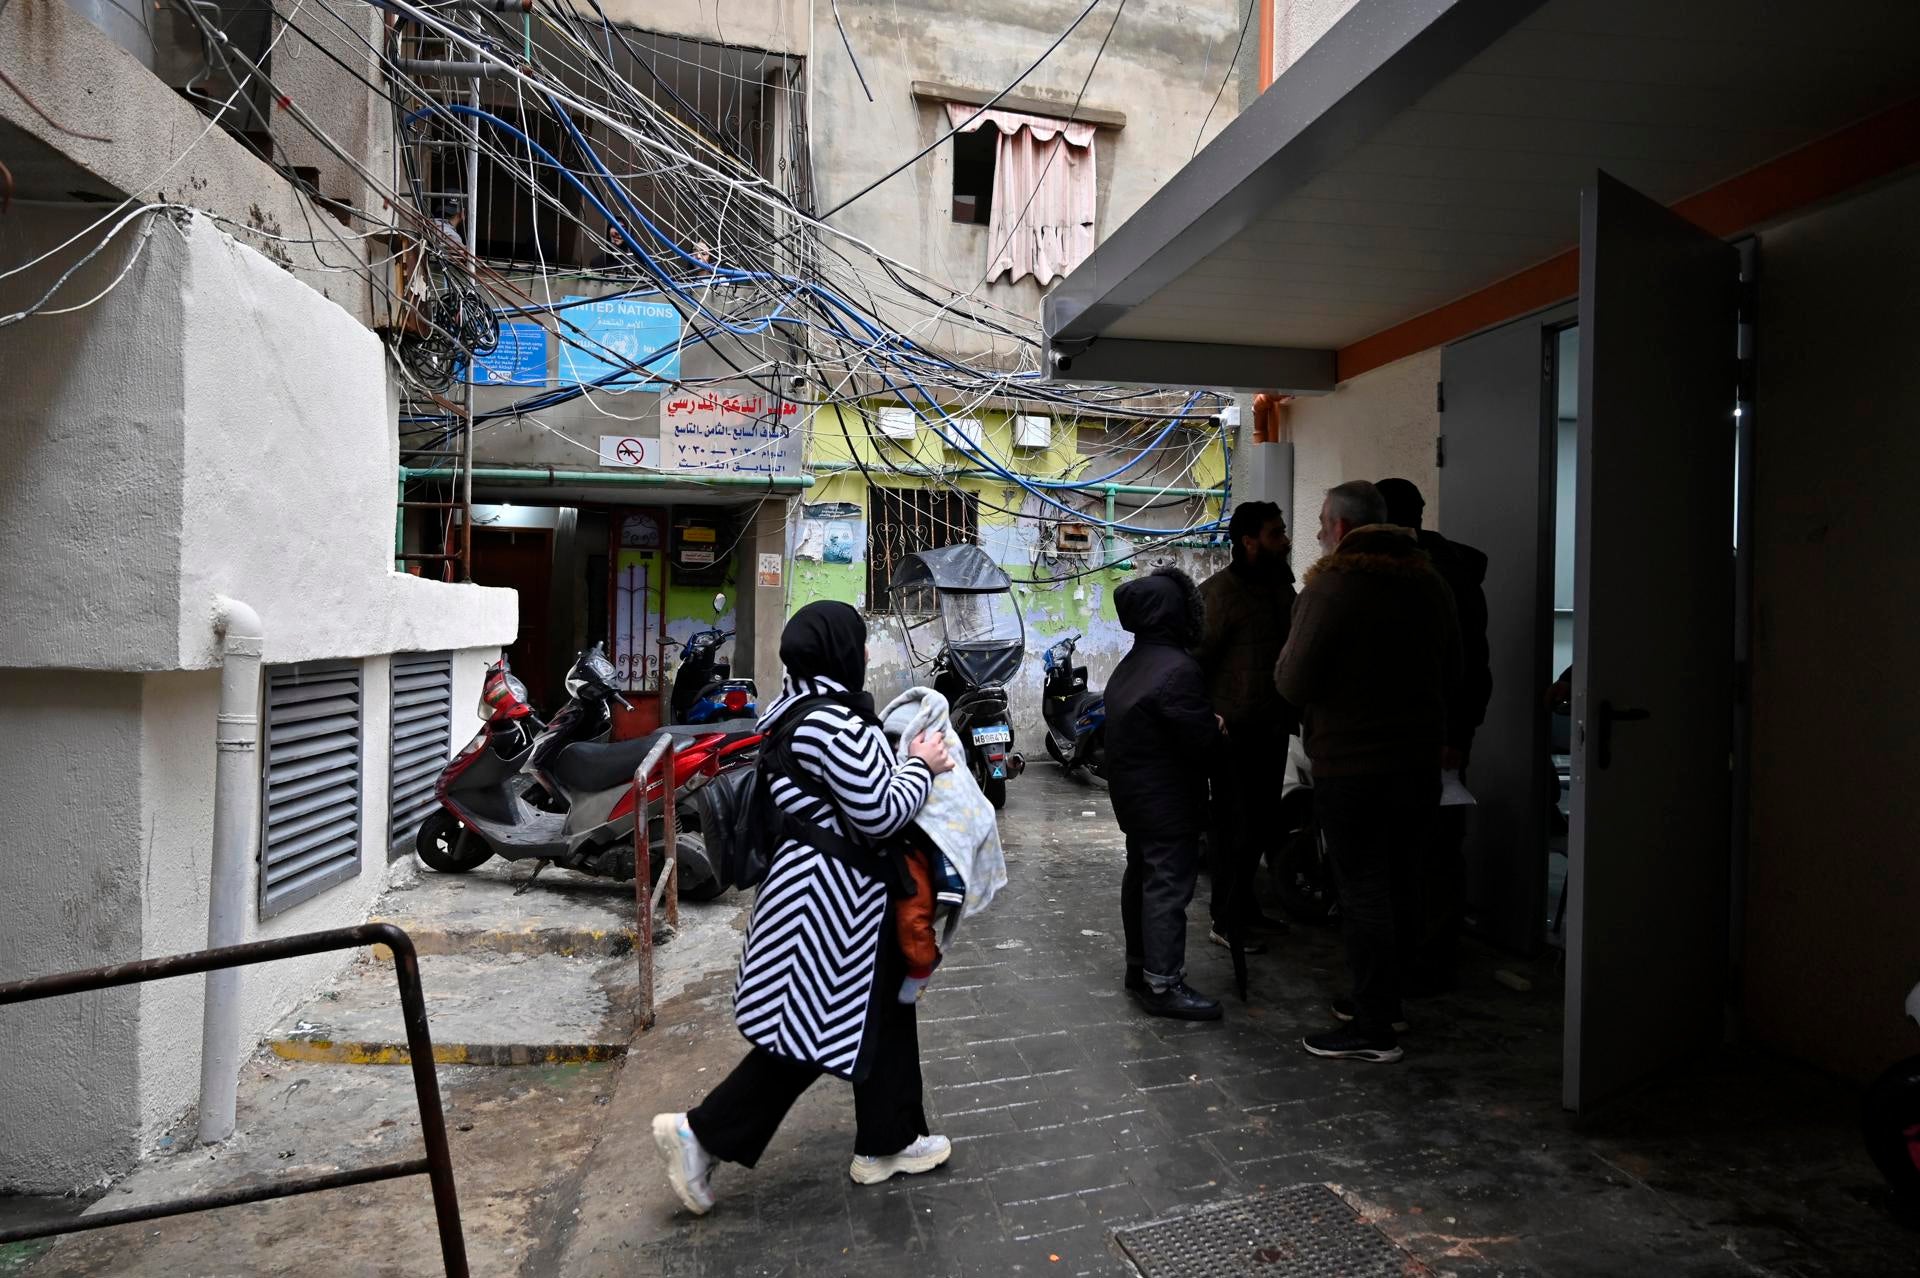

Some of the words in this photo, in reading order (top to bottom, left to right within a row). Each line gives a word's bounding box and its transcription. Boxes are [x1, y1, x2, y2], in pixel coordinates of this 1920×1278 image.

[565, 299, 614, 313] NITED
[618, 303, 673, 319] NATIONS
[667, 392, 718, 417] المدرسي
[722, 395, 762, 416] الدعم
